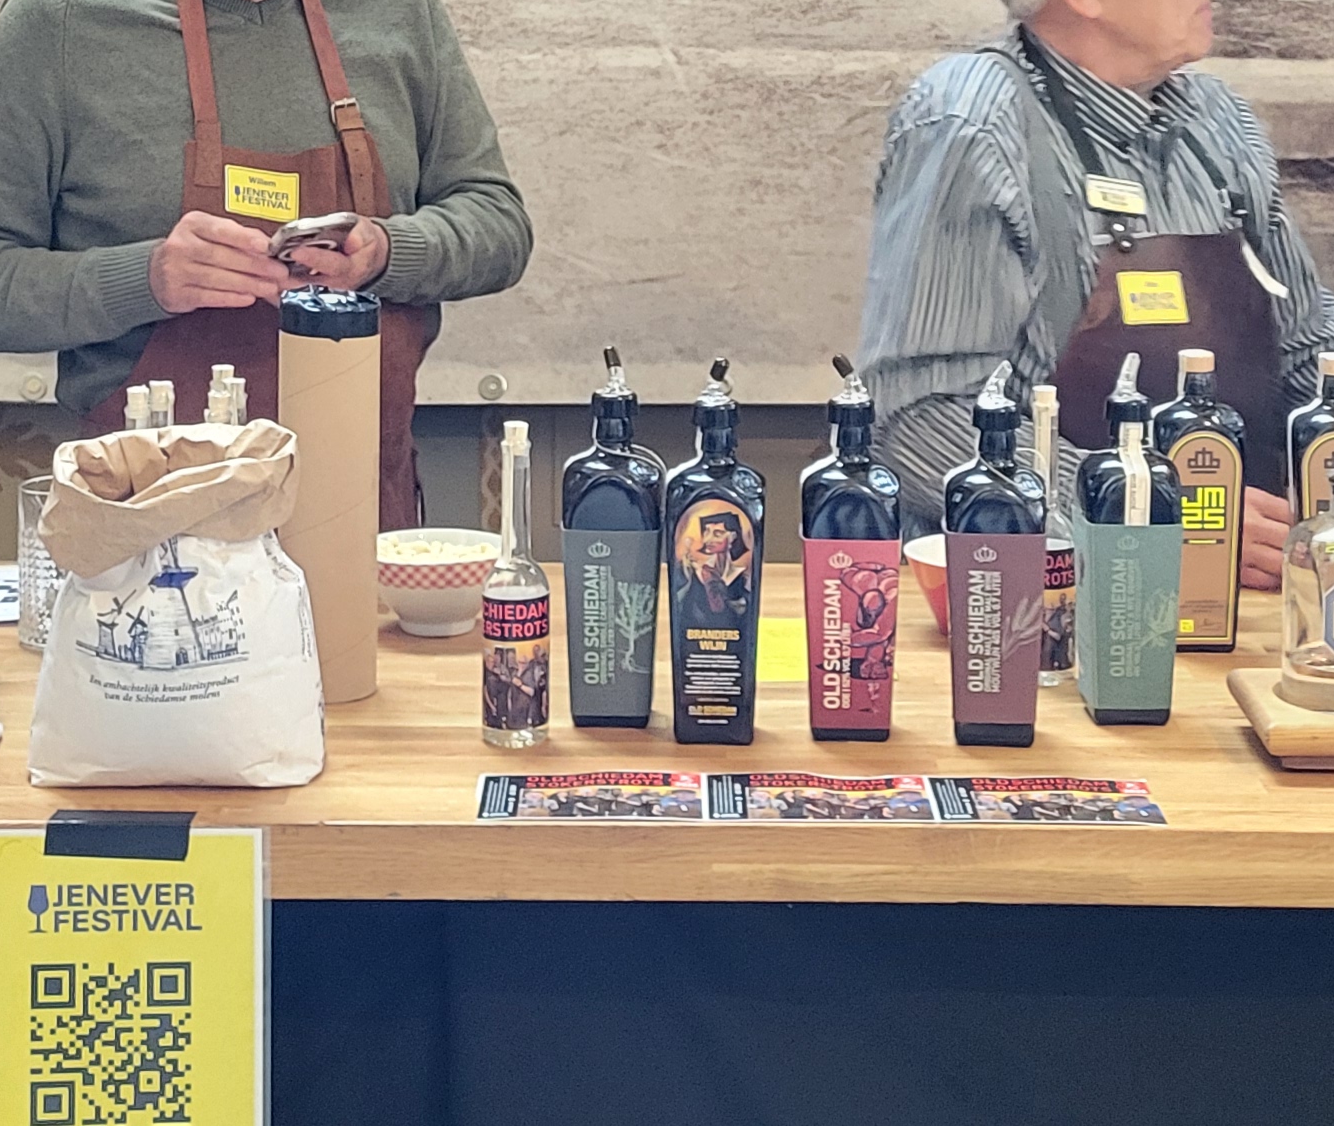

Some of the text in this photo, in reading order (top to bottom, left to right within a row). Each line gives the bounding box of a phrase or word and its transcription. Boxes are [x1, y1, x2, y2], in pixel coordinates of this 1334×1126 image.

[242, 186, 289, 201] JENEVER
[242, 196, 291, 211] FESTIVAL
[483, 599, 548, 621] CHIEDAM
[1109, 558, 1127, 677] OLD SCHIEDAM
[583, 564, 600, 685] OLD SCHIEDAM
[968, 569, 985, 692] OLD SCHIEDAM
[823, 579, 842, 710] OLD SCHIEDAM
[103, 680, 159, 694] ambachtelijk
[162, 675, 240, 694] kwaliteitsproduct
[104, 690, 221, 703] van de Schiedamse molens
[526, 778, 664, 788] STOKERSTROTS
[527, 772, 663, 783] OLD SCHIEDAM
[52, 883, 196, 907] JENEVER
[53, 908, 203, 933] FESTIVAL
